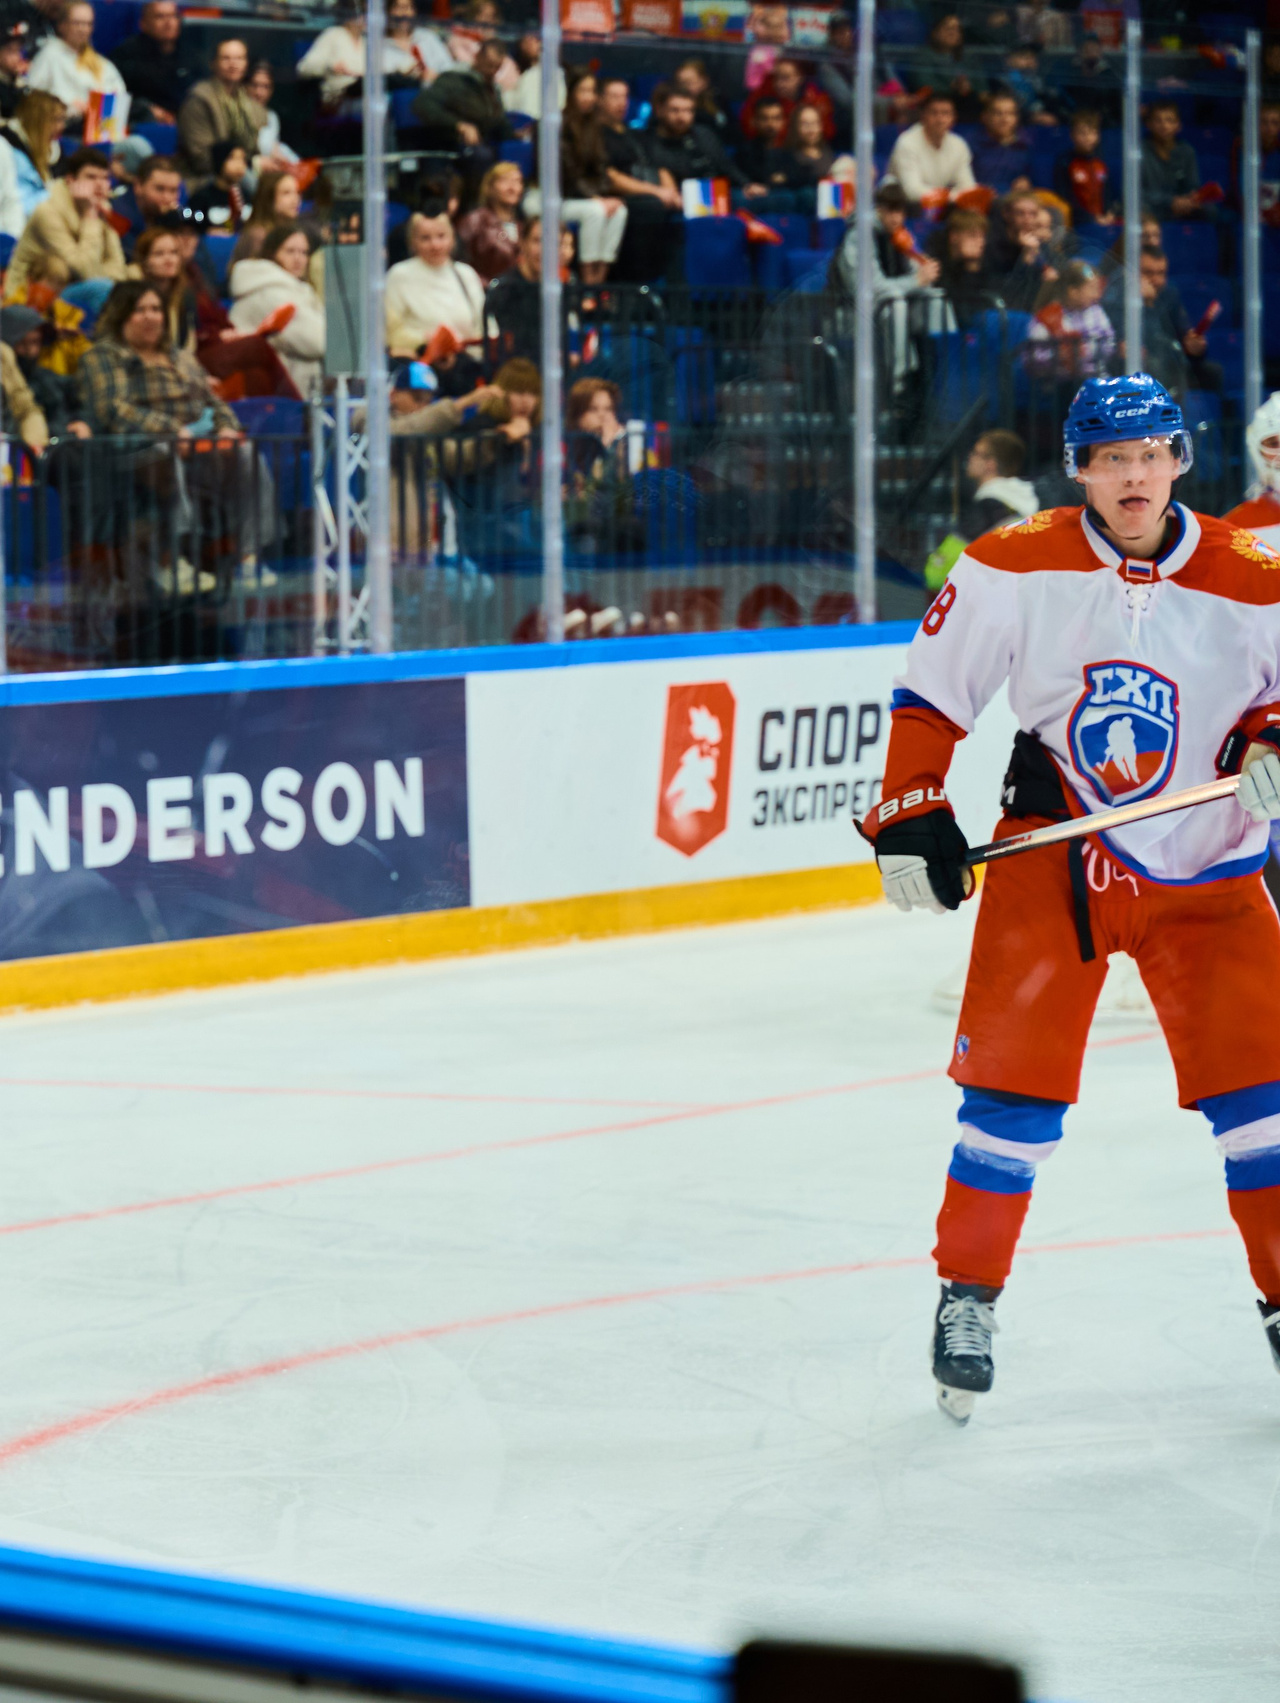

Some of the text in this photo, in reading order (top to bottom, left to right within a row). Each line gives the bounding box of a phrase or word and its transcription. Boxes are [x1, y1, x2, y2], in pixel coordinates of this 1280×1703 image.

[1115, 407, 1150, 419] CCM
[922, 577, 957, 636] 8
[1089, 667, 1175, 723] СХЛ
[758, 703, 882, 772] СПОР
